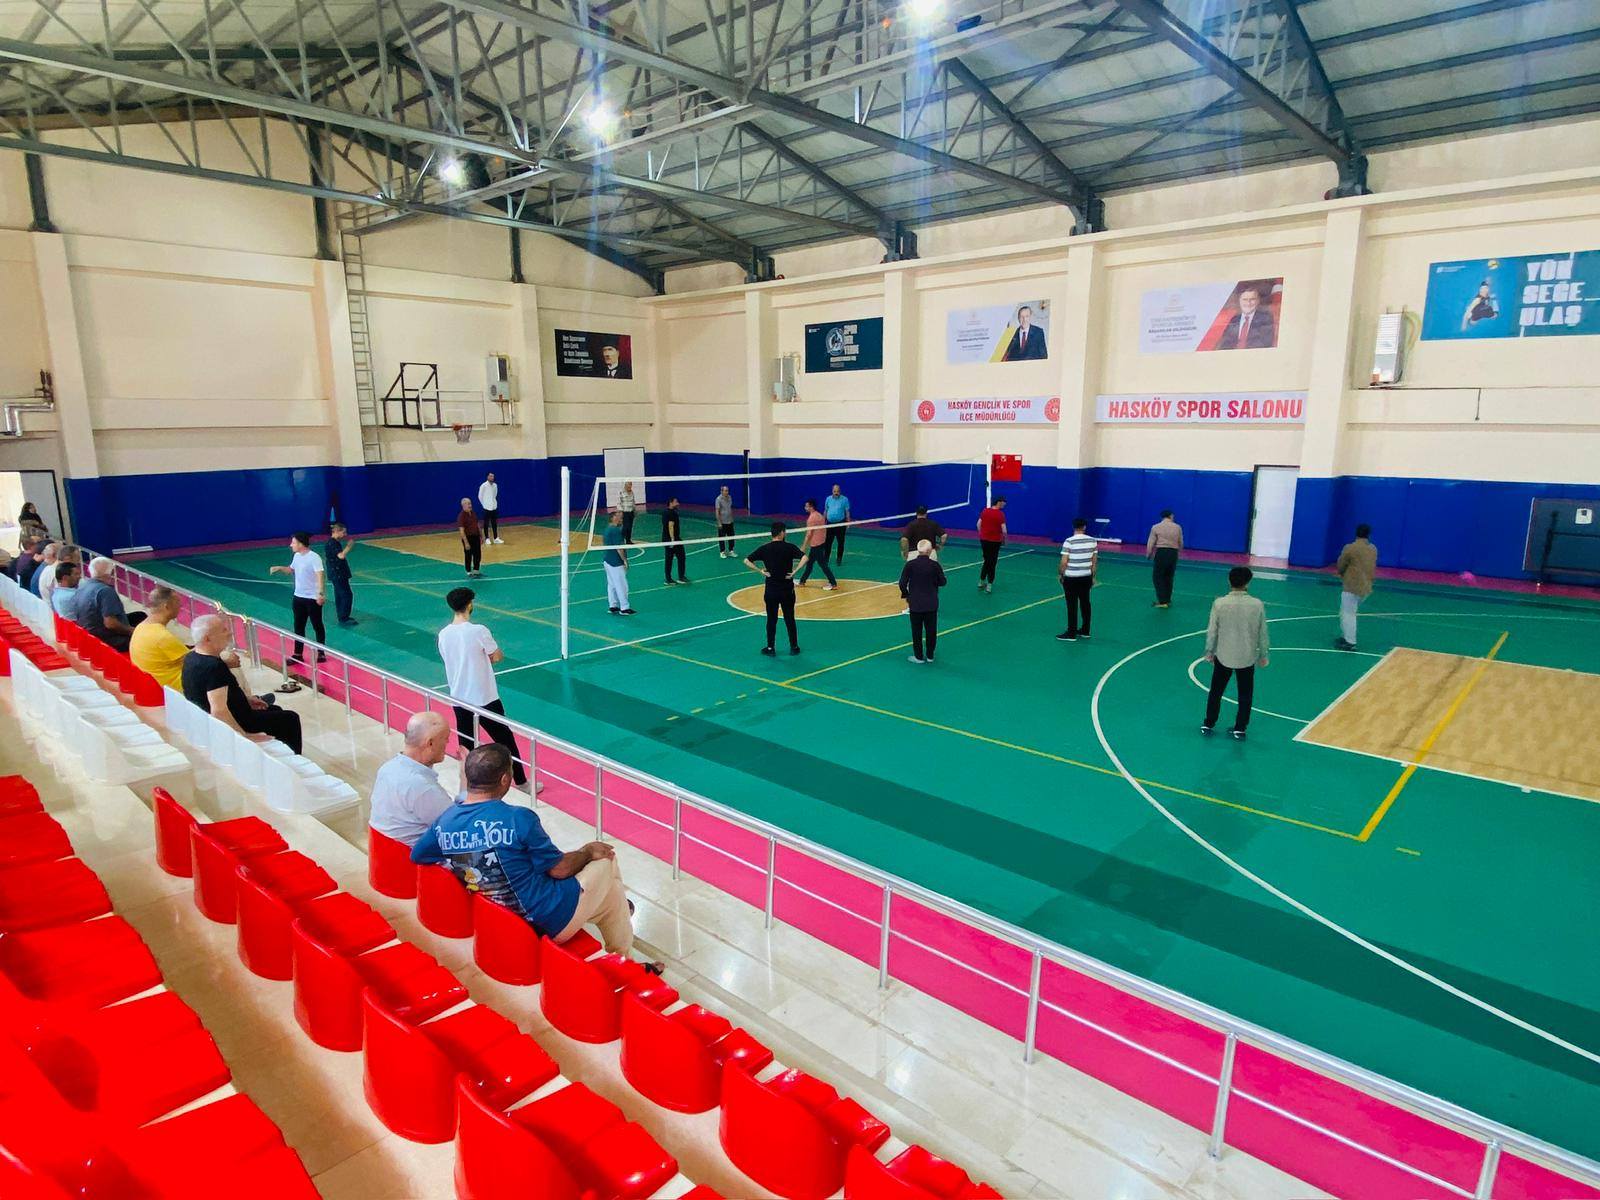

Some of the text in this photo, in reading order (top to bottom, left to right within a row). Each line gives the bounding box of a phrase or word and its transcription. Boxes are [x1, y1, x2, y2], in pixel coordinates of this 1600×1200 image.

[1519, 305, 1582, 326] ULAŞ
[948, 399, 972, 410] HASKÖY
[1002, 399, 1011, 409] VE
[1012, 399, 1031, 409] SPOR
[1108, 397, 1303, 418] HASKÖY SPOR SALONU
[474, 820, 515, 848] YOU
